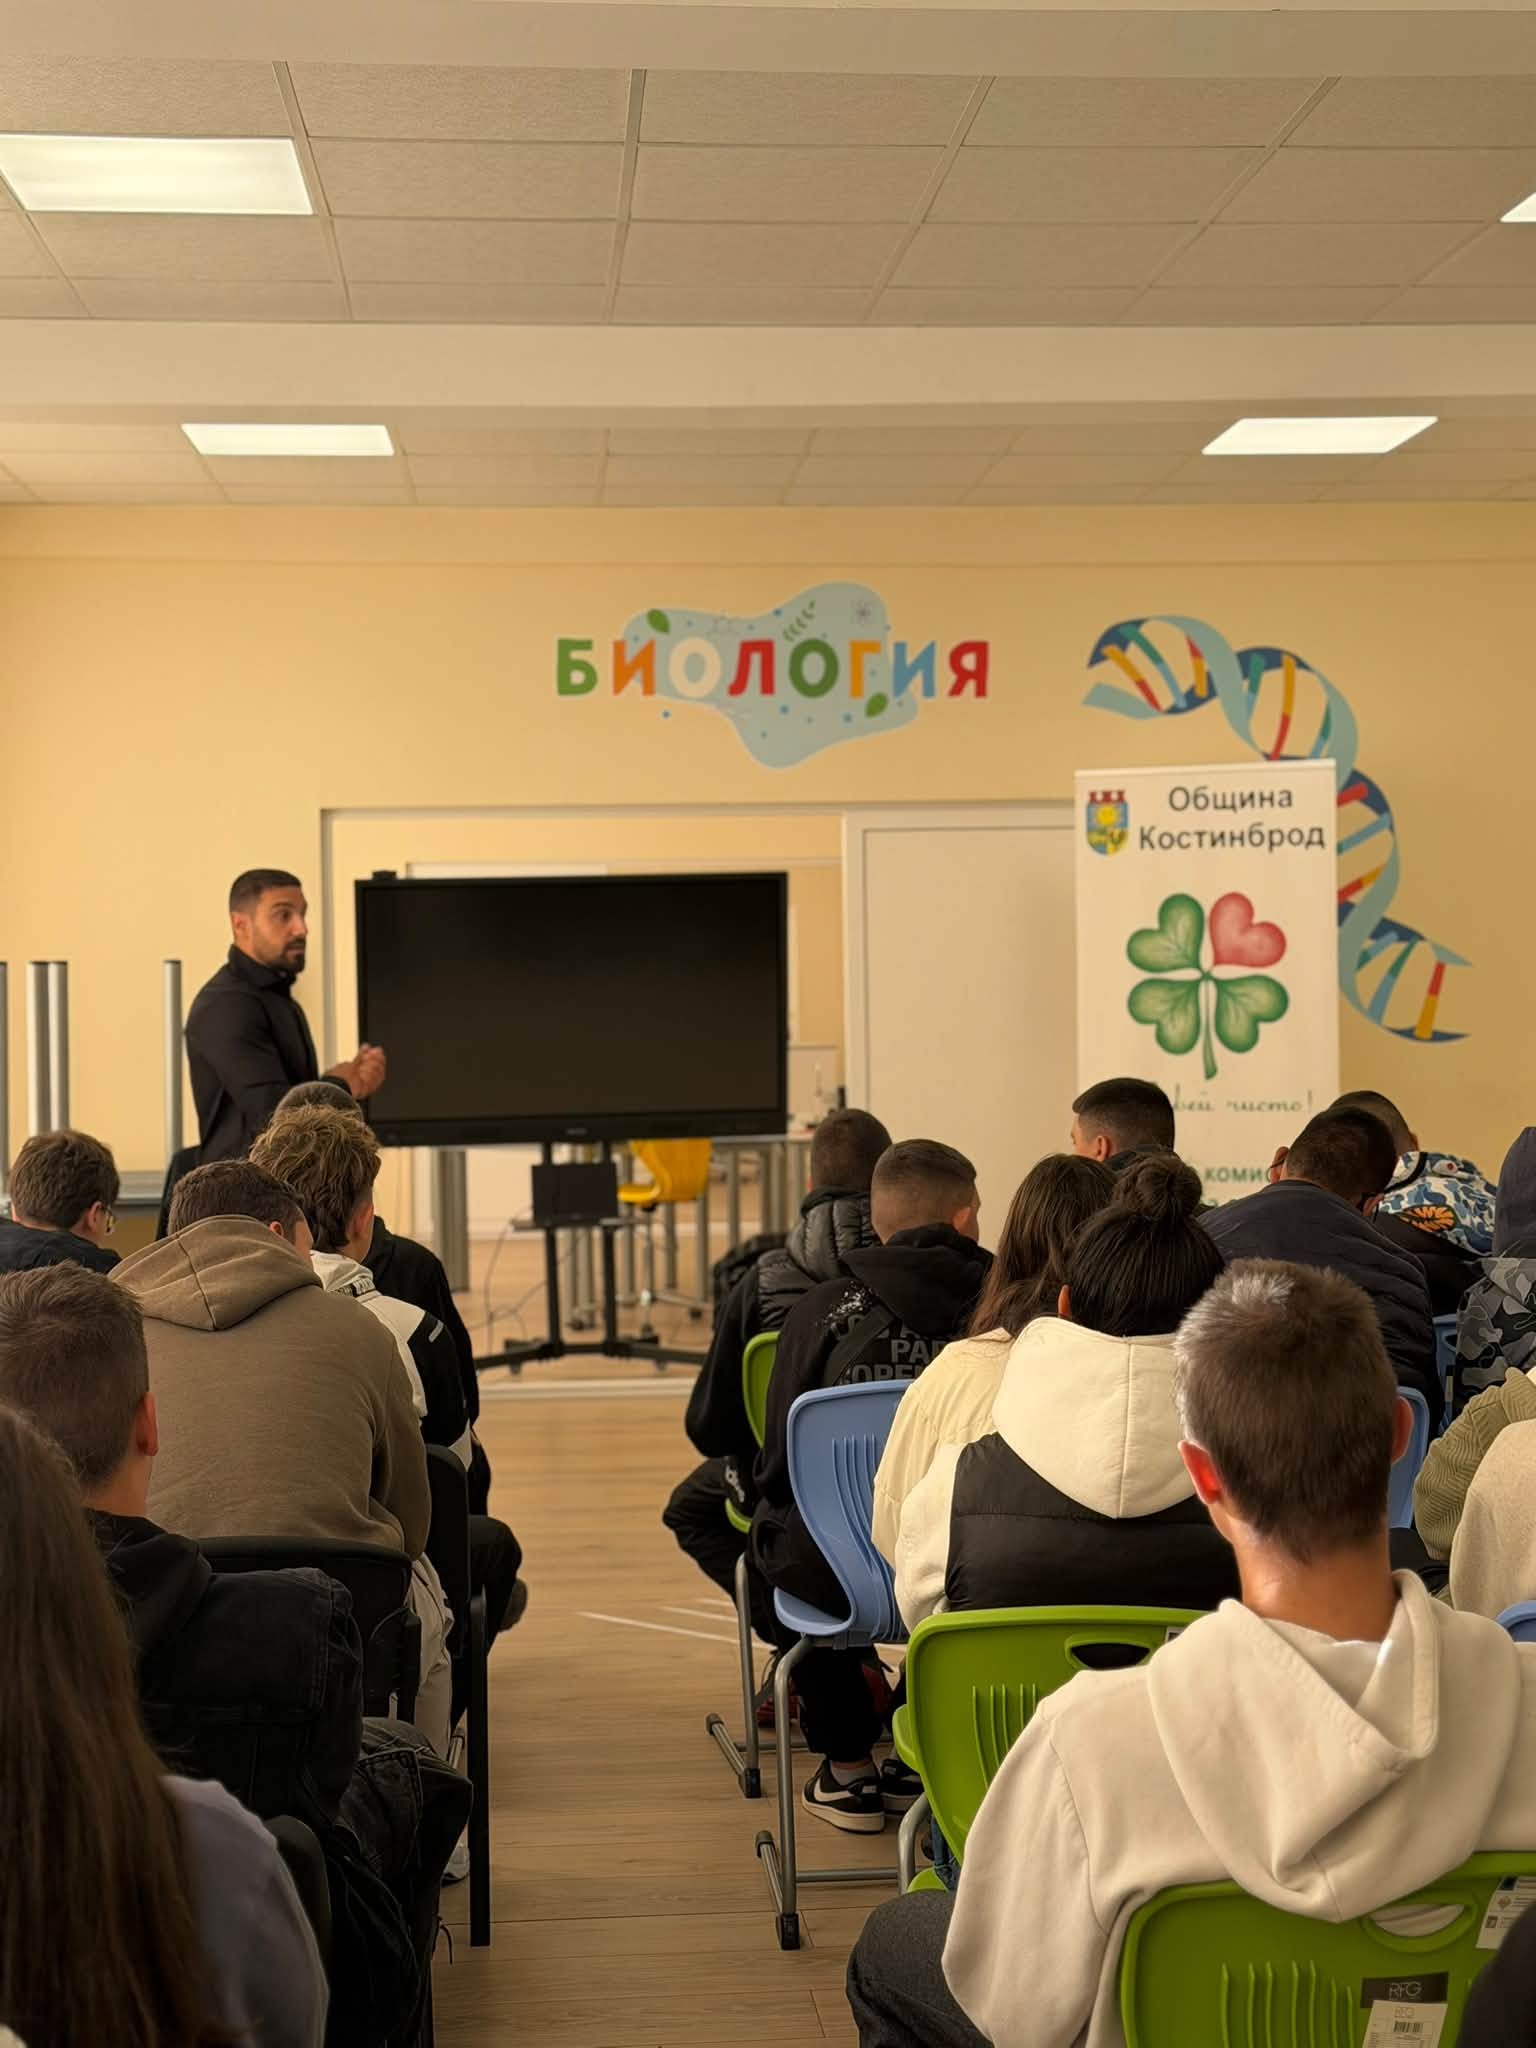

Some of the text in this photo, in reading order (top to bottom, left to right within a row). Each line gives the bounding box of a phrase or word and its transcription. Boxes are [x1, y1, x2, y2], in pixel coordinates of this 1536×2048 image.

[556, 637, 990, 699] БИОЛОГИЯ
[1168, 785, 1293, 813] Община
[1139, 822, 1326, 853] Костинброд
